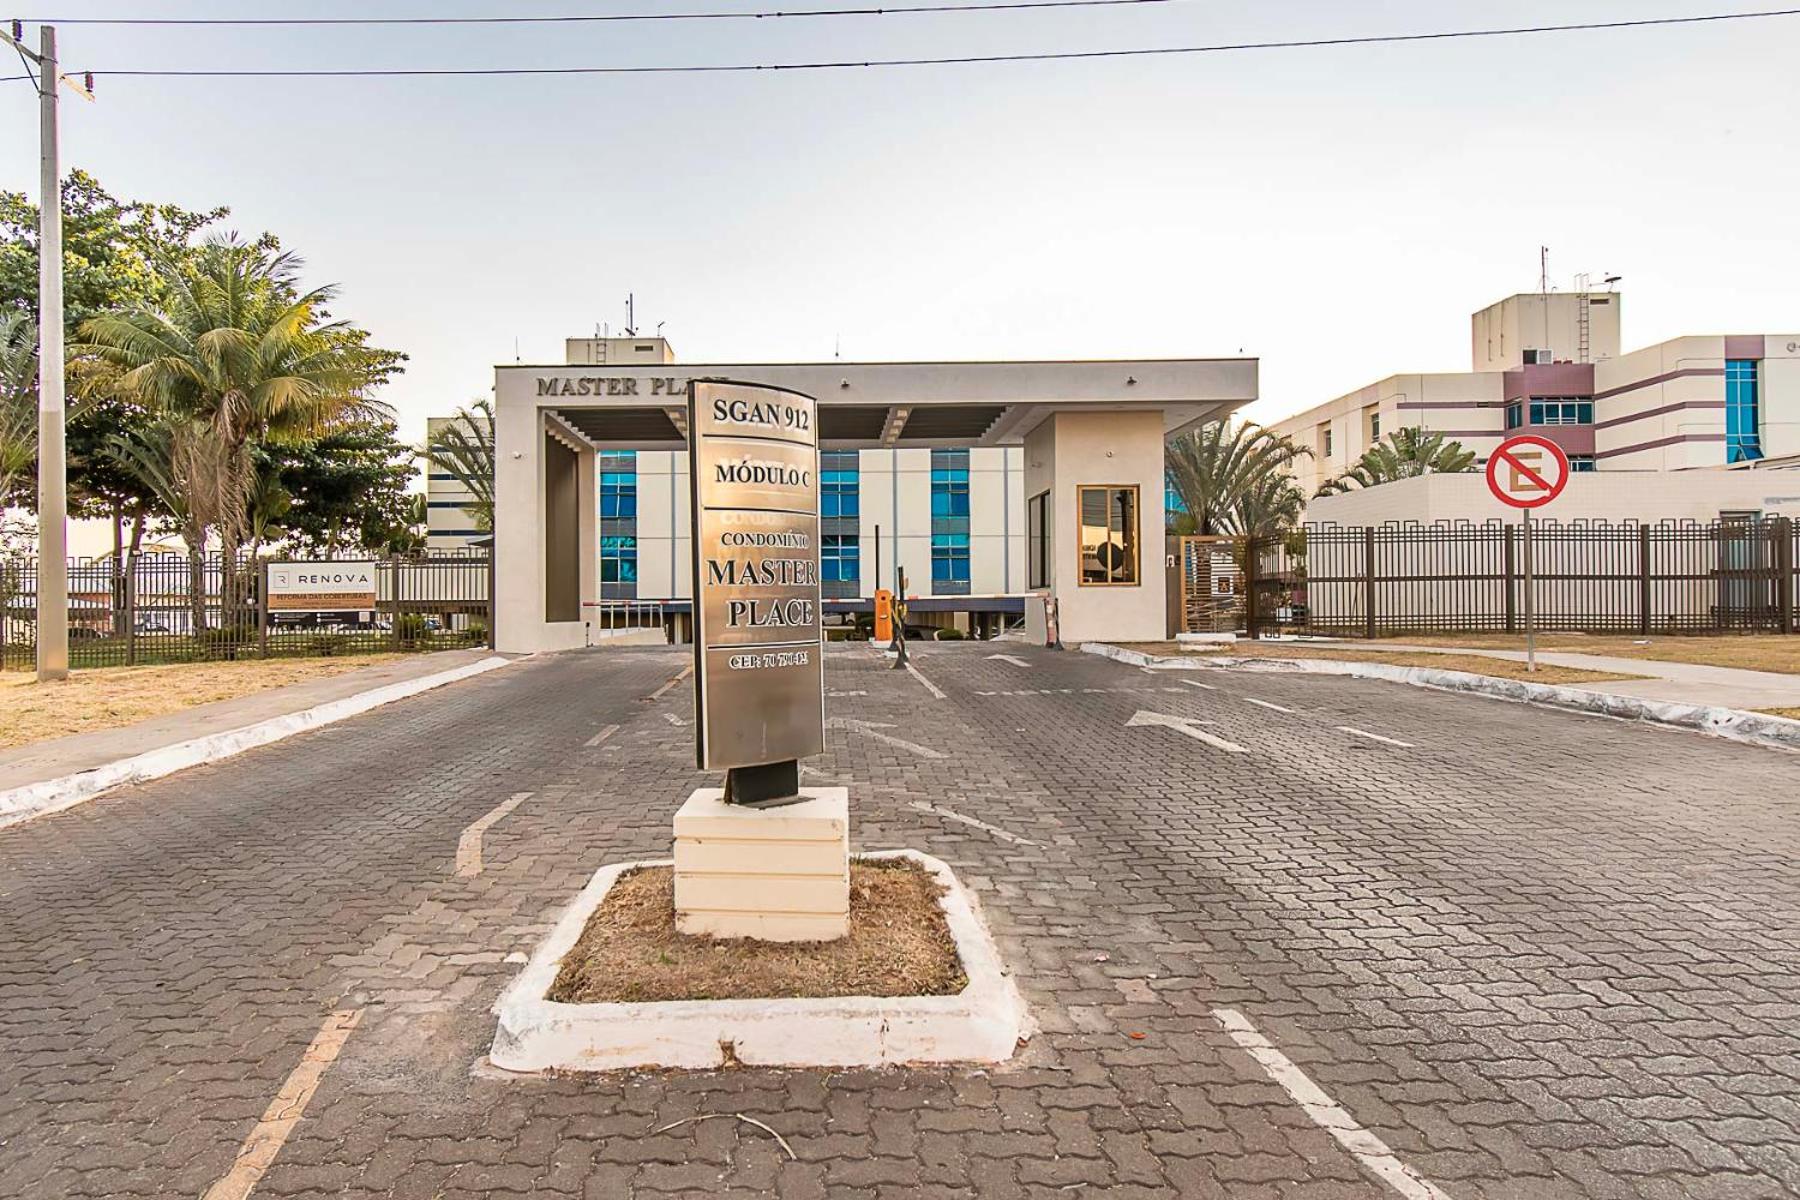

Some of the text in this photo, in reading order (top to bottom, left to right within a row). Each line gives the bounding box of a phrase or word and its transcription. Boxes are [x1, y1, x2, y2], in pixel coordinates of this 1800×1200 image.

[537, 377, 640, 397] MASTER
[713, 399, 809, 431] SGAN 912
[714, 460, 811, 488] MÓDULO C
[1510, 452, 1546, 492] E
[298, 574, 369, 584] RENOVA
[706, 558, 817, 586] MASTER
[727, 599, 813, 627] PLACE
[729, 654, 761, 669] CEP:
